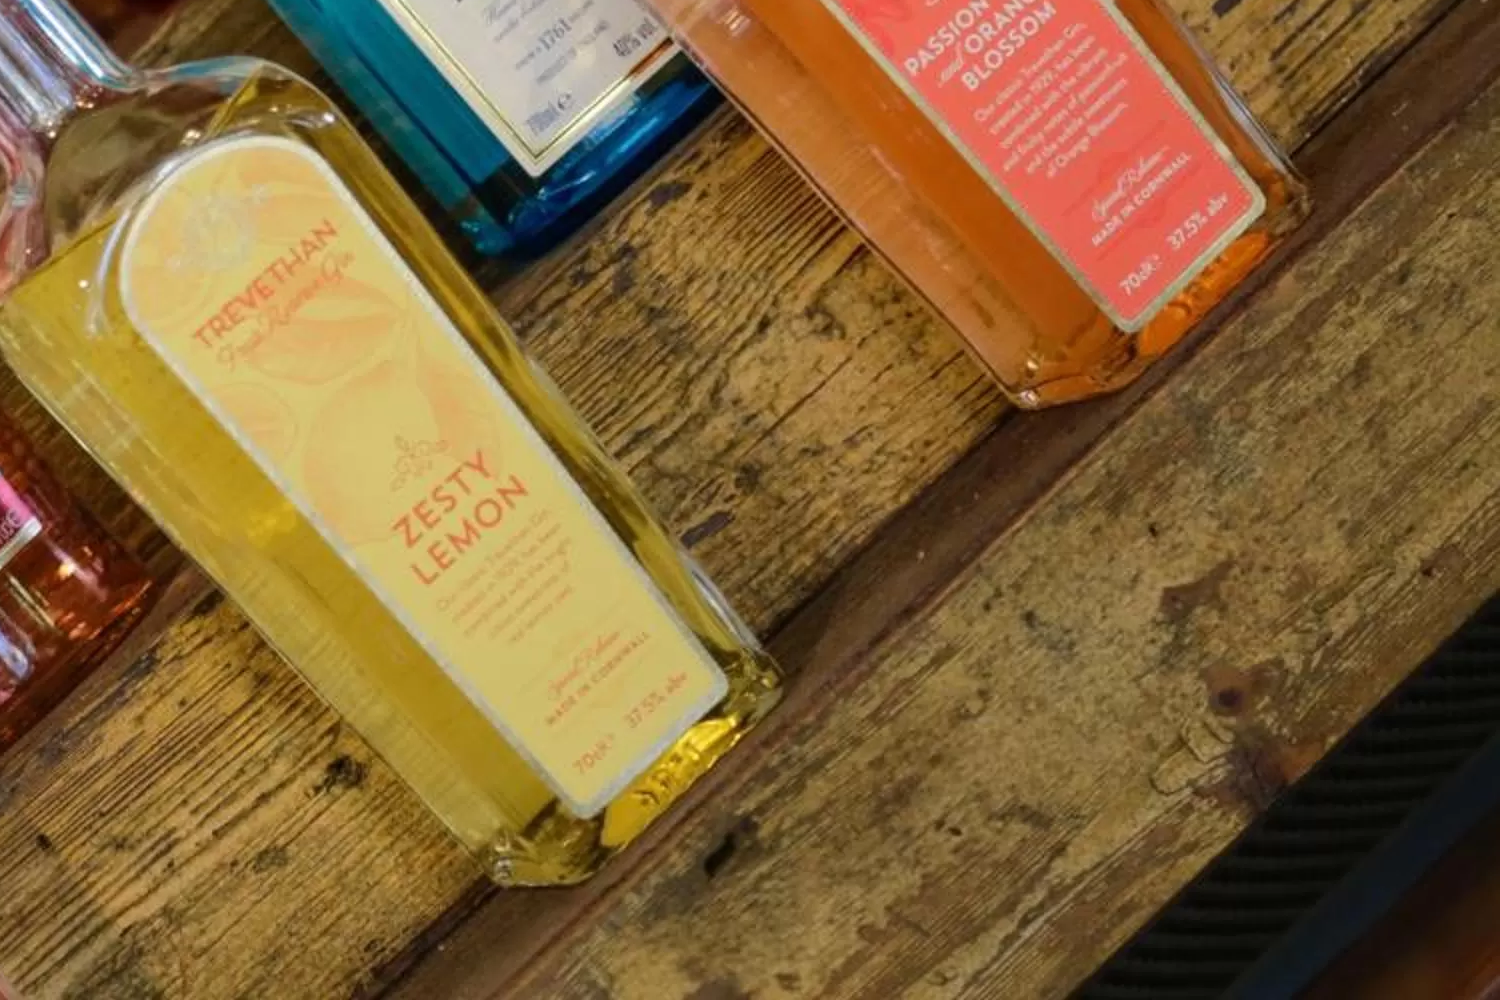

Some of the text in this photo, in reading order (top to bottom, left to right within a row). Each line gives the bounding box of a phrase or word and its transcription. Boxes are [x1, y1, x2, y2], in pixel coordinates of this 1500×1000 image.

[937, 42, 966, 87] and
[959, 0, 1058, 92] BLOSSOM
[190, 217, 339, 350] TREVETHAN
[388, 447, 496, 549] ZESTY
[408, 472, 531, 588] LEMON
